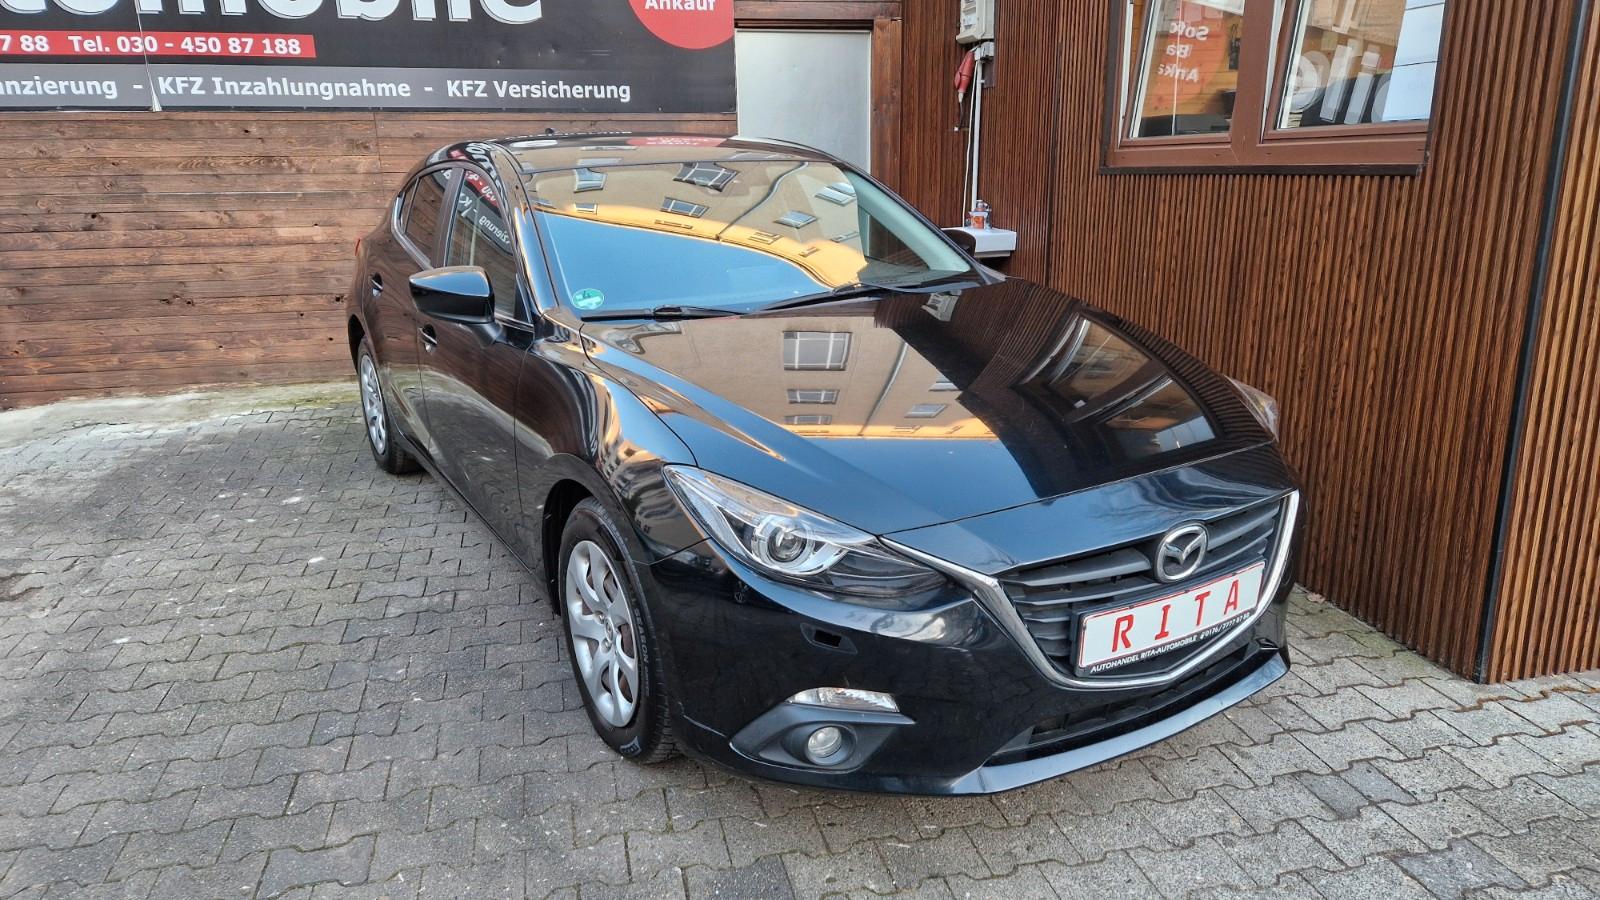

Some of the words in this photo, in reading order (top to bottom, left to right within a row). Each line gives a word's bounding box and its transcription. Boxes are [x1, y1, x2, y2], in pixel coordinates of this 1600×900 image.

[645, 0, 716, 12] Ankauf
[19, 35, 50, 52] 88
[68, 35, 110, 53] Tel.
[116, 36, 158, 53] 030
[181, 37, 221, 54] 450
[228, 37, 253, 54] 87
[262, 38, 302, 55] 188
[158, 77, 206, 95] KFZ
[211, 77, 411, 101] Inzahlungnahme
[446, 80, 488, 98] KFZ
[494, 80, 632, 103] Versicherung
[1090, 654, 1140, 674] AUTOHANDEL
[1140, 635, 1198, 661] RITA-AUTOMOBILE
